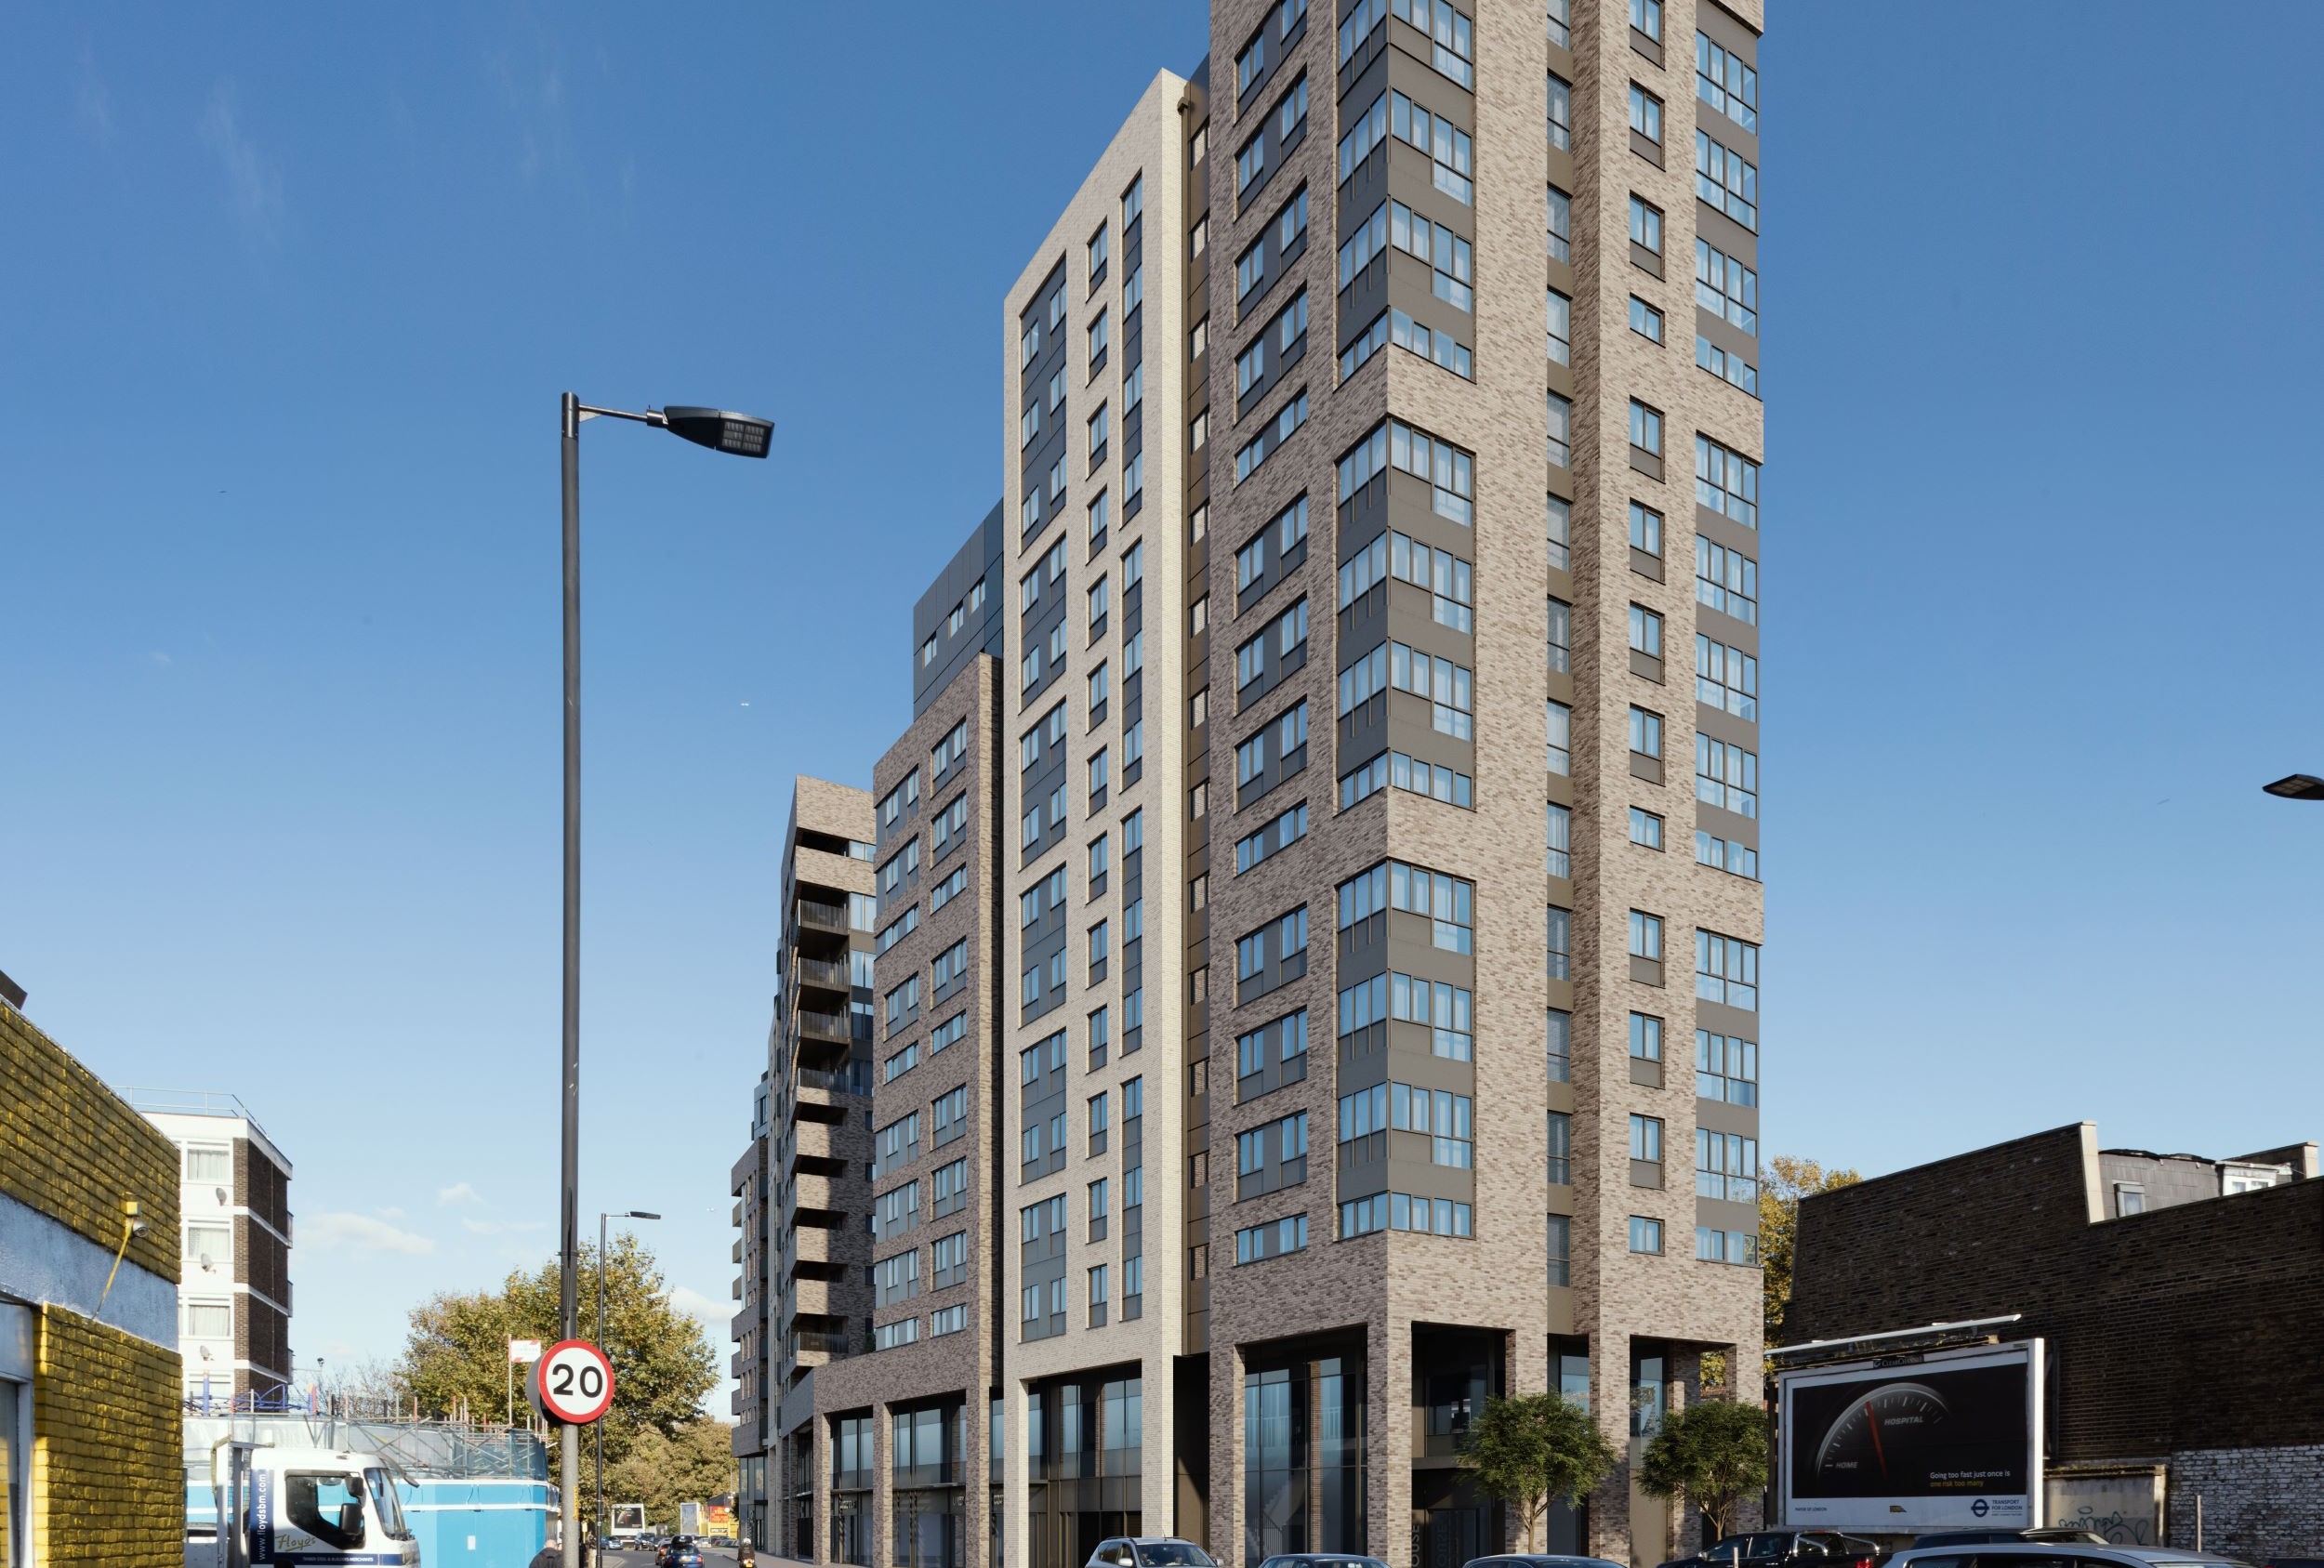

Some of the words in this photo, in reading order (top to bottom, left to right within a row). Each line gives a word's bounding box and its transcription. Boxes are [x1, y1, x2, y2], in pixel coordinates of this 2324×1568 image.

[552, 1364, 602, 1398] 20
[1884, 1416, 1923, 1425] HOSPITAL
[1974, 1470, 1986, 1479] just
[257, 1474, 268, 1560] www.floydsbm.com
